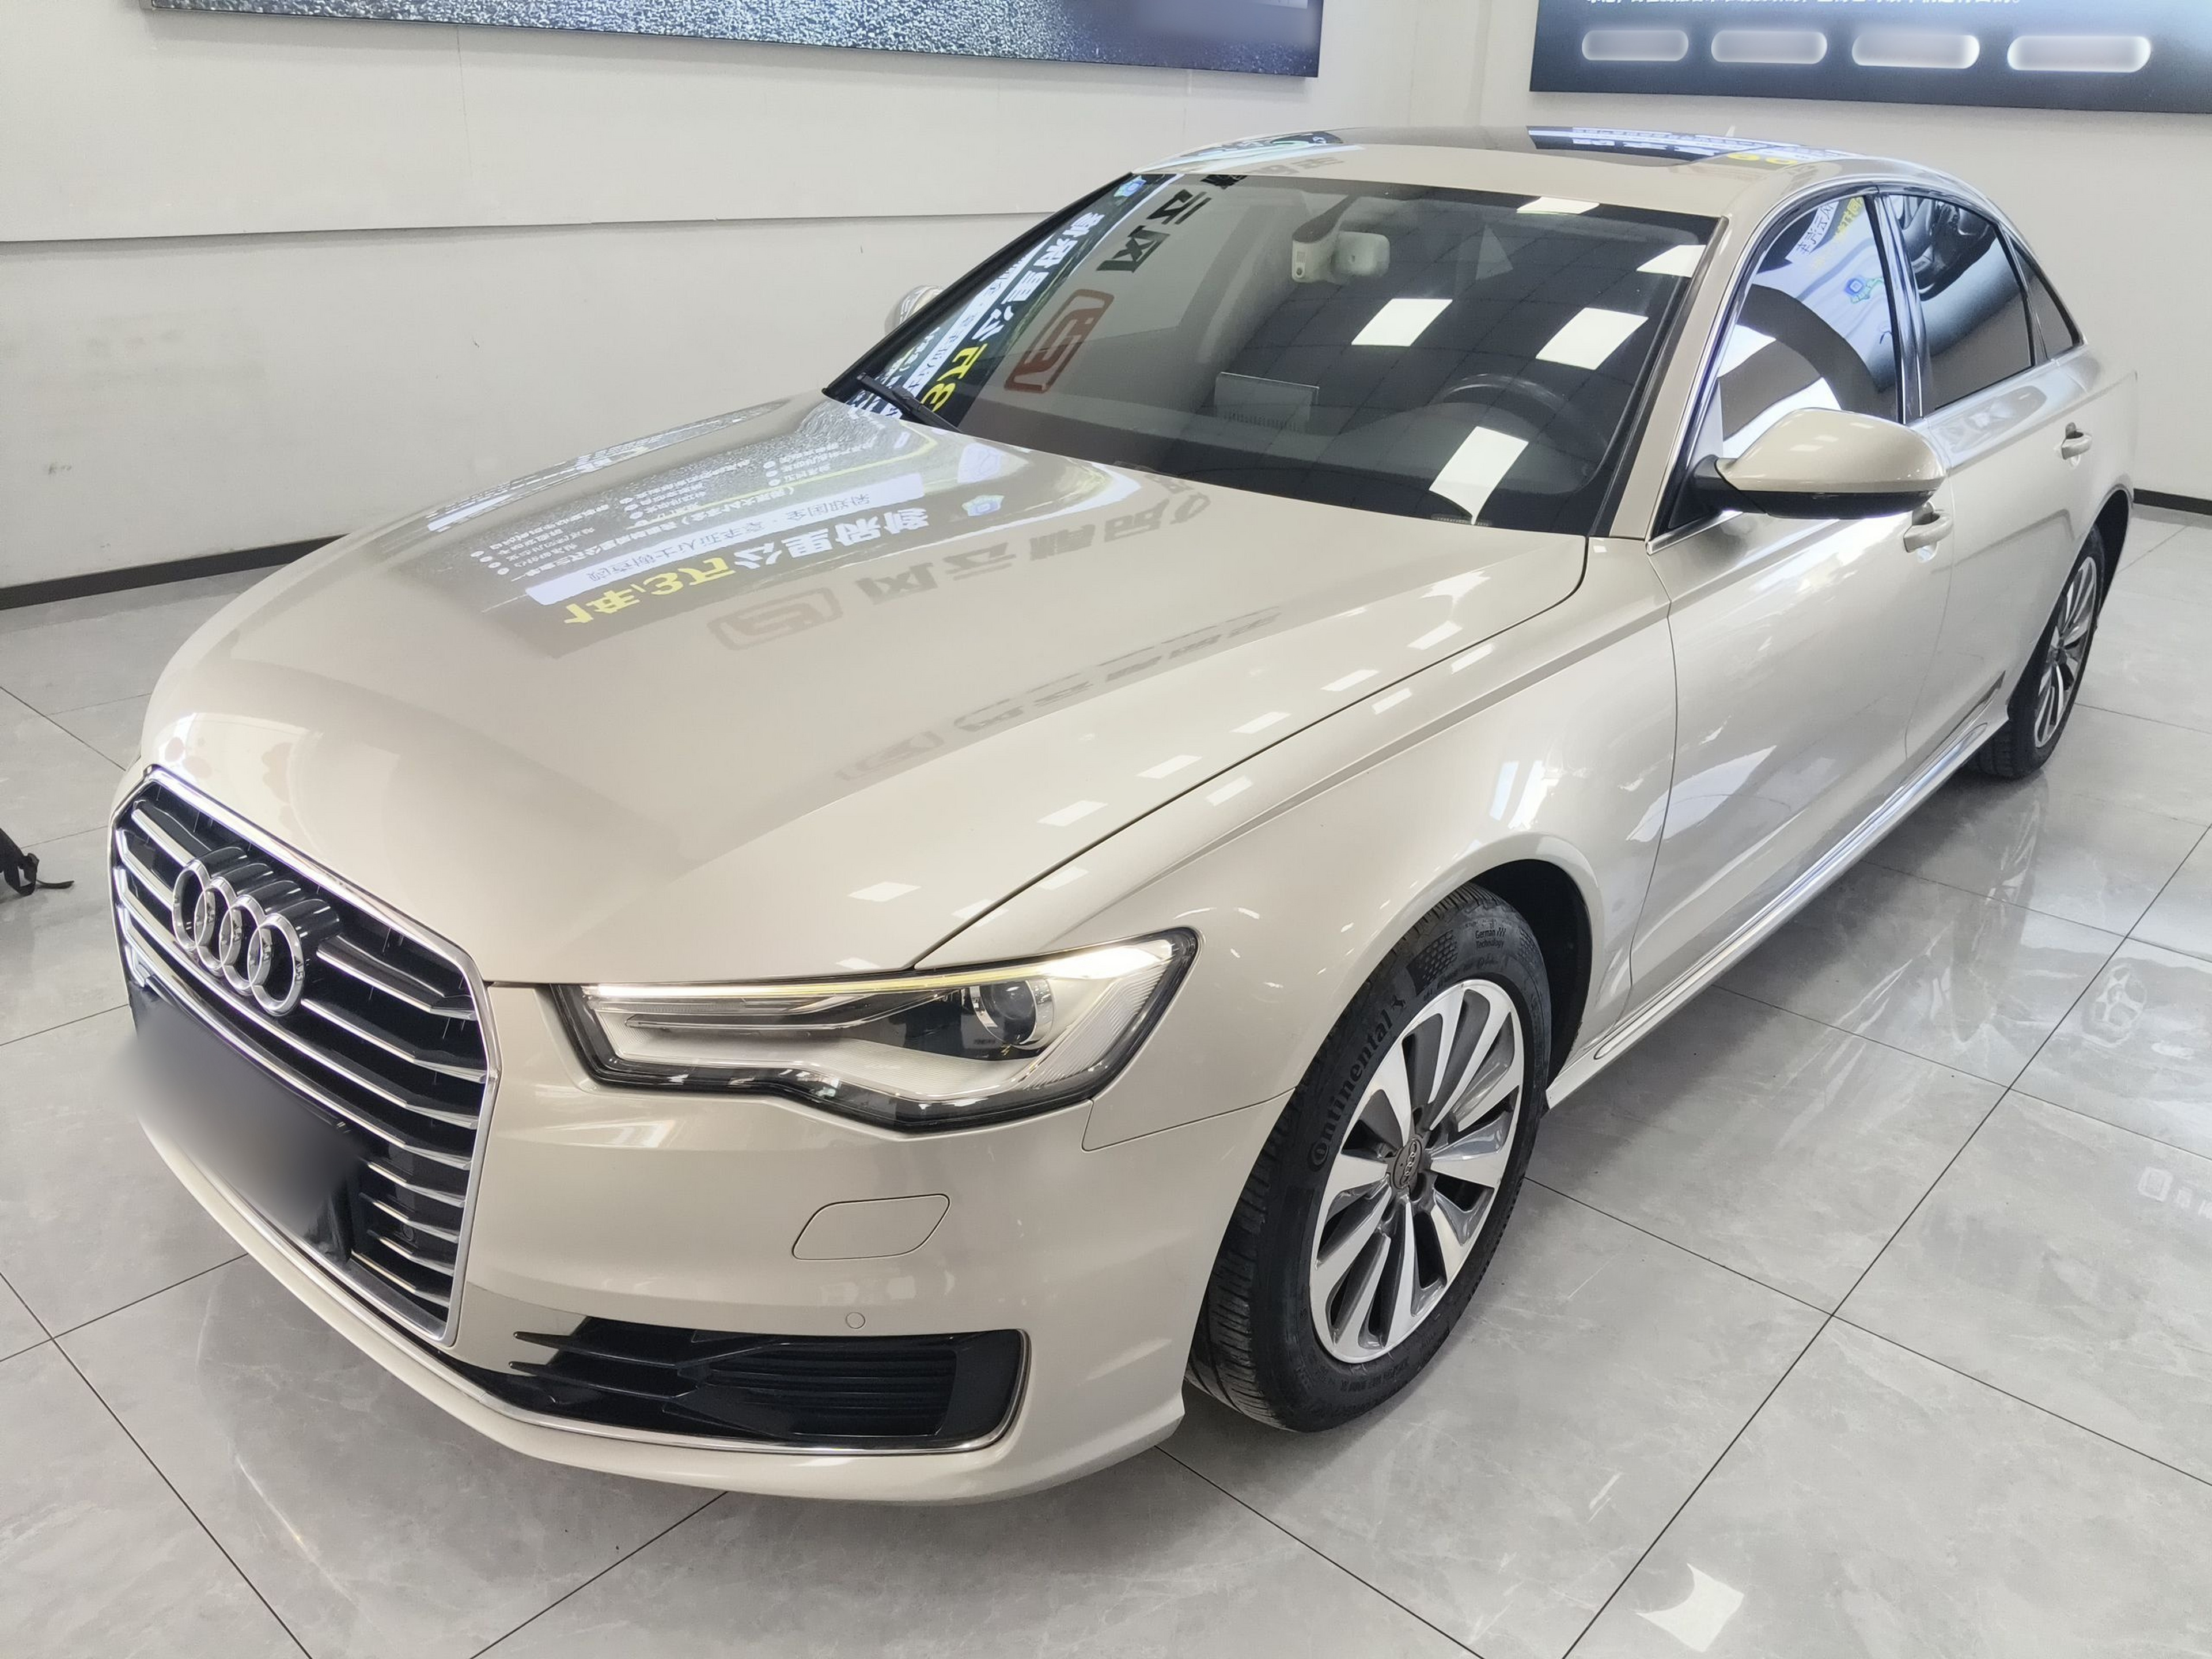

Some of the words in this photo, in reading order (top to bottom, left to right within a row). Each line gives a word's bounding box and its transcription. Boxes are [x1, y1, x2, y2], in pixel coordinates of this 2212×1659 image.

[1475, 929, 1496, 939] German
[1476, 940, 1505, 949] Technology
[1310, 1009, 1393, 1168] Continental
